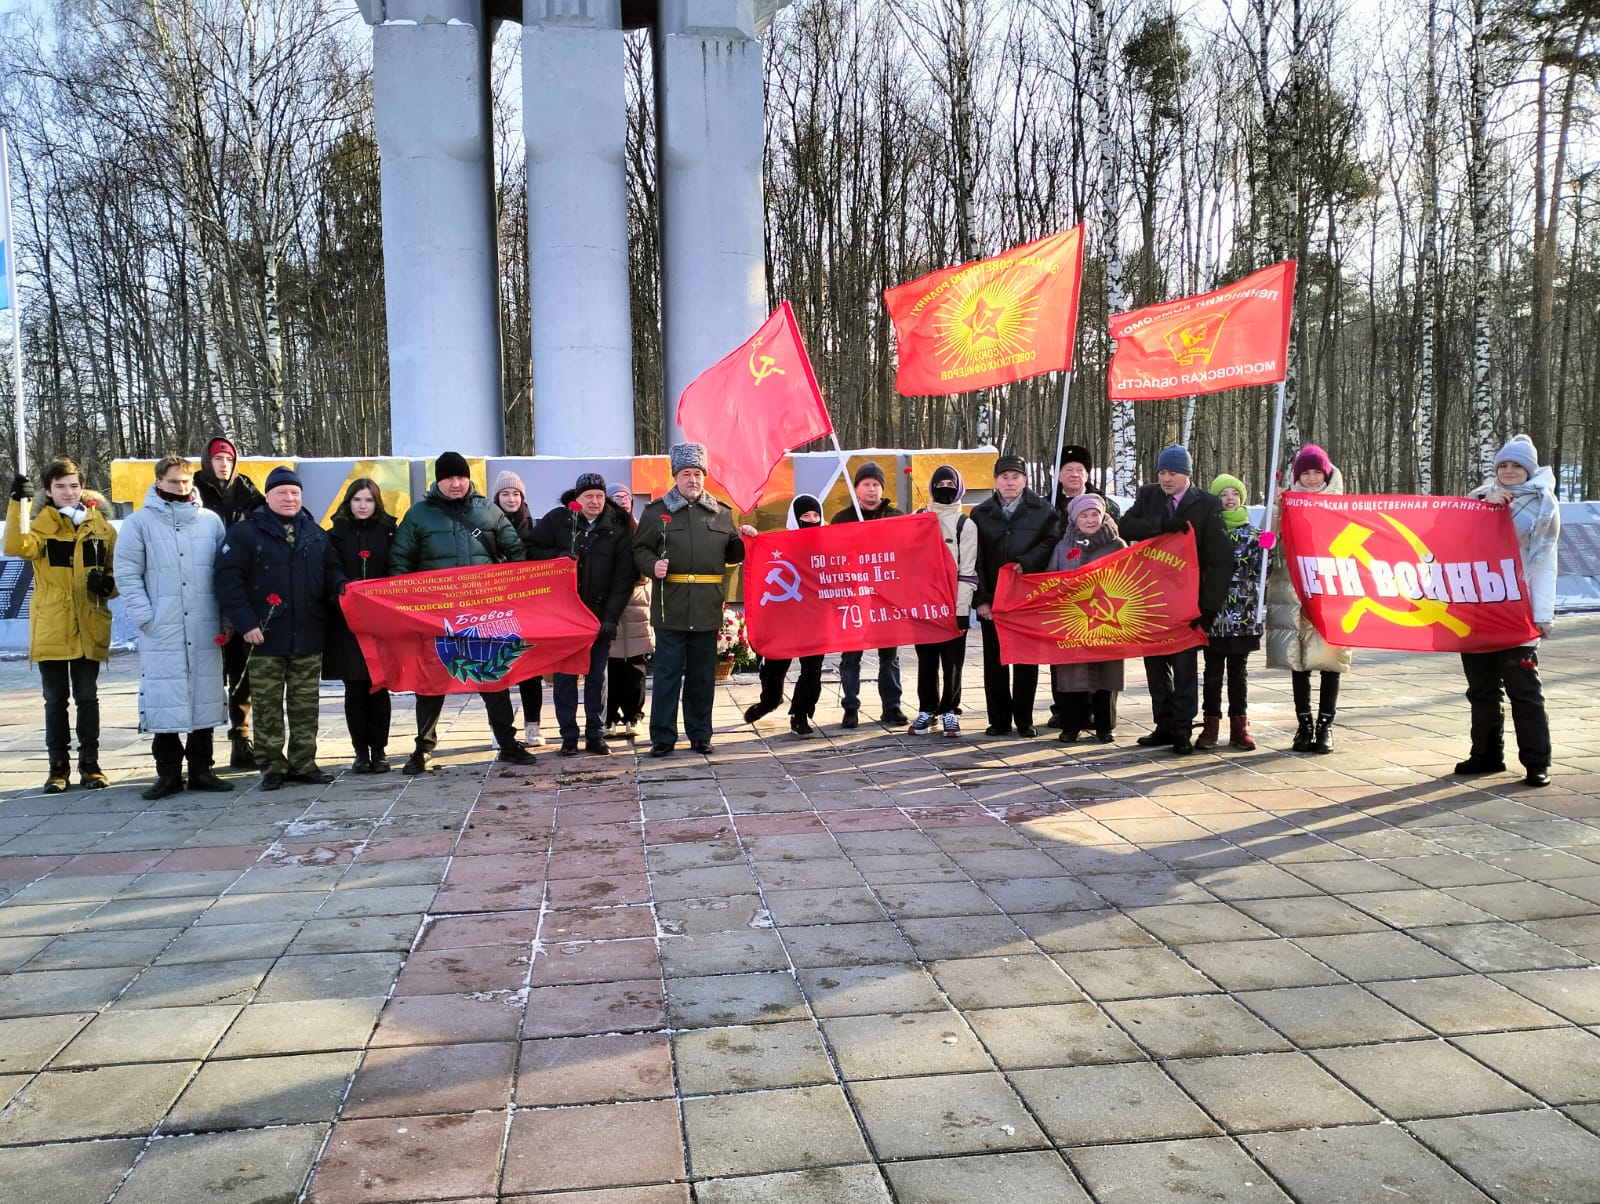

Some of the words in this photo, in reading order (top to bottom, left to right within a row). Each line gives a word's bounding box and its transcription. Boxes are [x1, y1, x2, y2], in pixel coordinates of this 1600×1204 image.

[1352, 500, 1428, 512] ОБЩЕСТВЕННАЯ
[810, 554, 826, 569] 150
[457, 569, 514, 581] ОБЩЕСТВЕННОЕ
[1297, 555, 1366, 599] ДЕТИ
[1370, 552, 1522, 604] ВОЙНЫ
[459, 595, 504, 608] ОБЛАСТНОЕ
[507, 586, 551, 601] ОТДЕЛЕНИЕ
[455, 609, 513, 625] Боевое
[837, 604, 863, 630] 79
